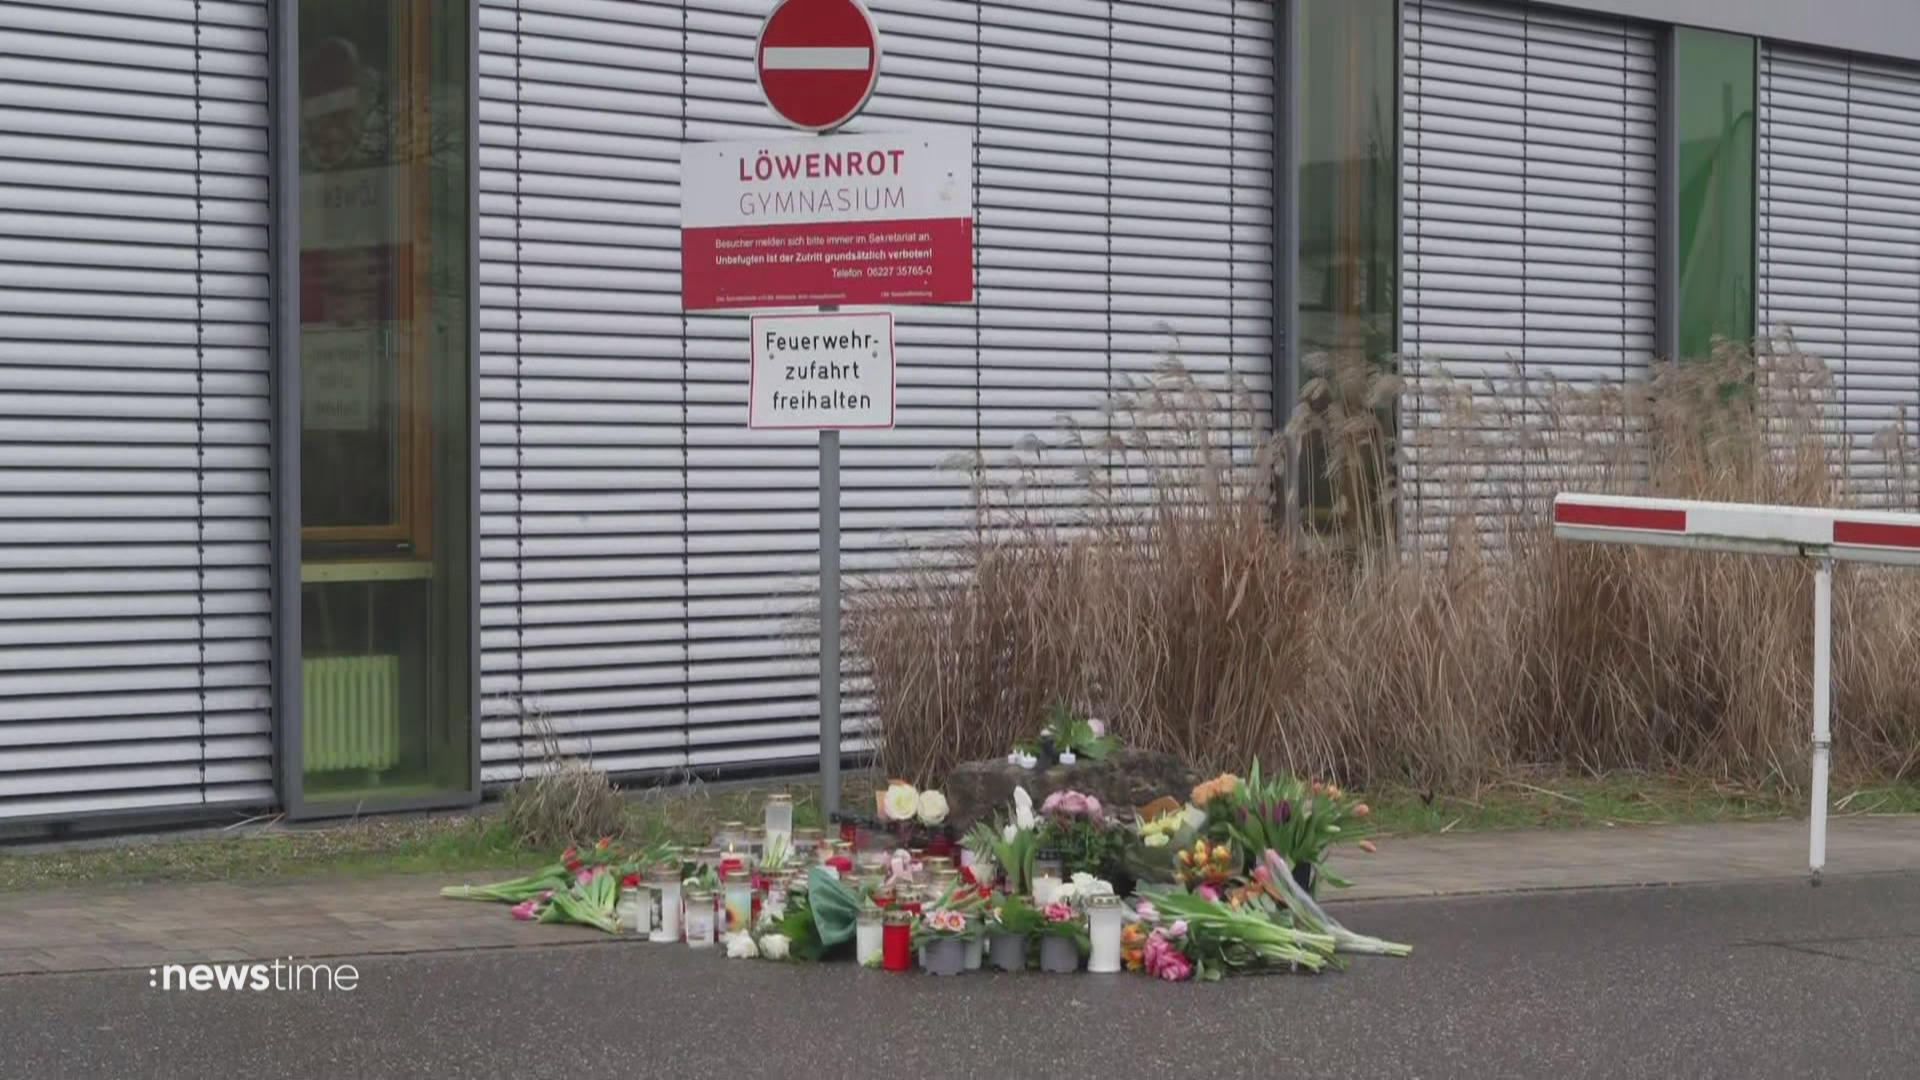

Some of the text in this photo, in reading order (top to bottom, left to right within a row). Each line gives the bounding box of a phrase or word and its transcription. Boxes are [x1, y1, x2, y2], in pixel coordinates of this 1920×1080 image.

[739, 149, 905, 181] LÖWENROT
[740, 187, 905, 216] GYMNASIUM
[715, 232, 932, 249] Besucher melden sich bitte immer im Sekretariat an.
[715, 248, 933, 266] Unbefugten ist der Zutritt grundsätzlich verboten!
[832, 265, 933, 279] Telefon 06227 35765-0
[766, 329, 879, 351] Feuerwehr-
[785, 360, 860, 380] zufahrt
[773, 390, 871, 410] freihalten
